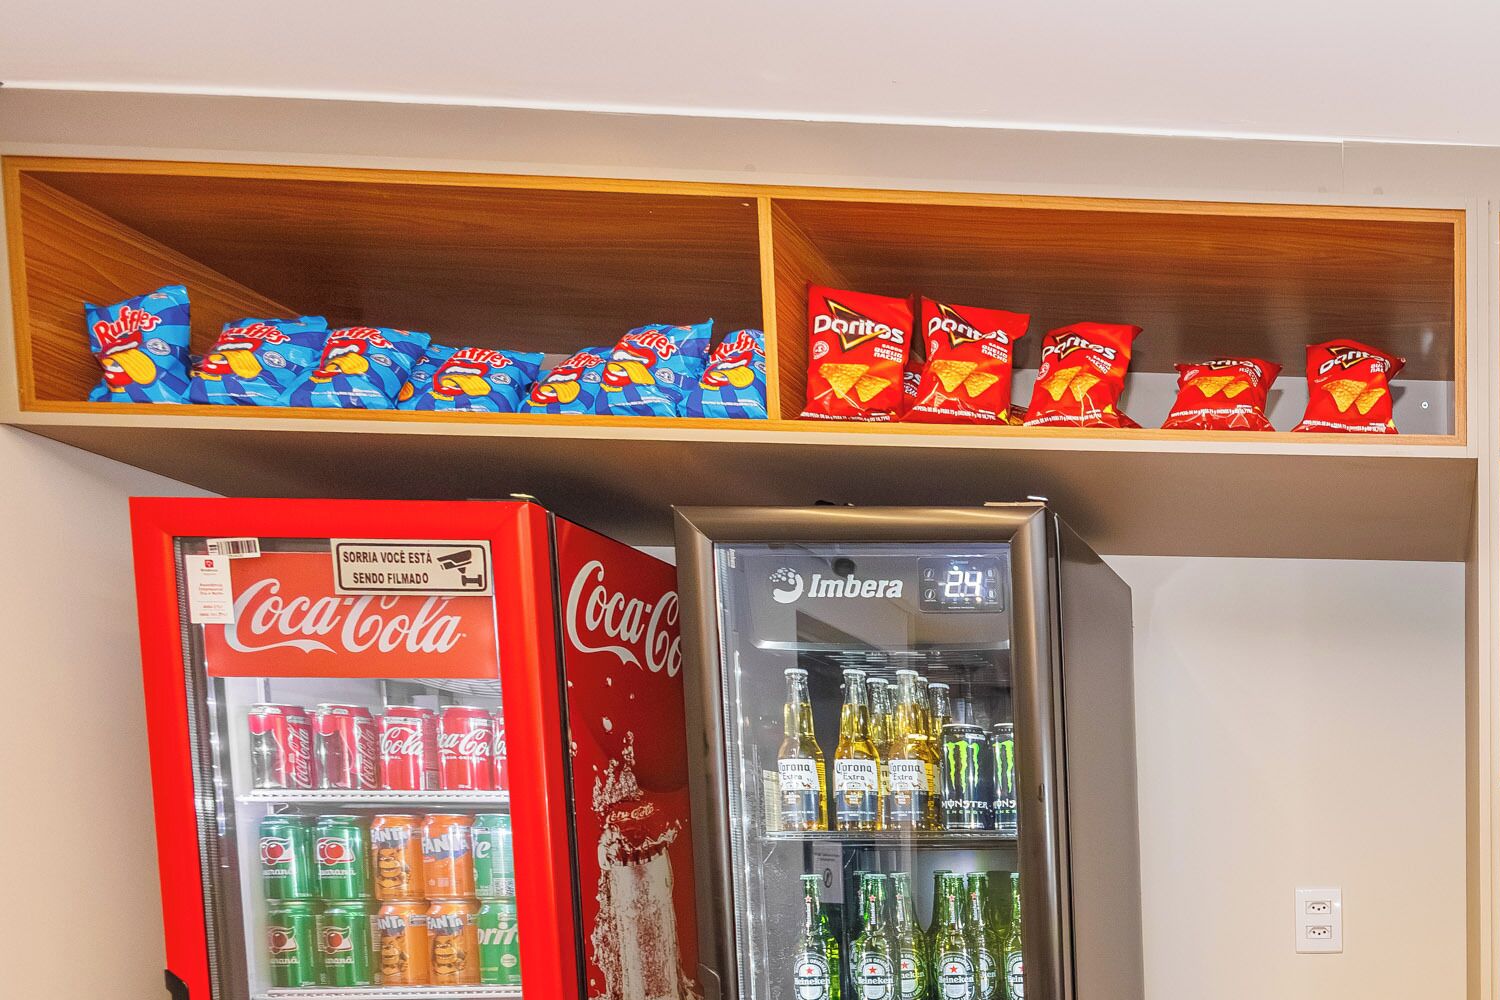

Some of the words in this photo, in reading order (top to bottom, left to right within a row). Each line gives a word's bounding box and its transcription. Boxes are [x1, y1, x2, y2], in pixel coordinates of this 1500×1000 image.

[91, 305, 162, 348] Ruffles
[813, 314, 905, 345] Doritos
[928, 317, 1009, 345] Doritos
[1042, 336, 1117, 362] Doritos
[1202, 359, 1263, 377] oritos
[343, 551, 379, 564] SORRIA
[381, 549, 407, 564] VOCÊ
[408, 549, 433, 565] ESTÁ
[353, 572, 385, 585] SENDO
[387, 572, 430, 585] FILMADO
[807, 574, 904, 599] Imbera
[224, 578, 464, 655] Coca-Cola
[566, 560, 682, 677] Coca-Co
[836, 761, 874, 774] Corona
[941, 798, 988, 809] MONSTER
[858, 976, 894, 985] Heineken
